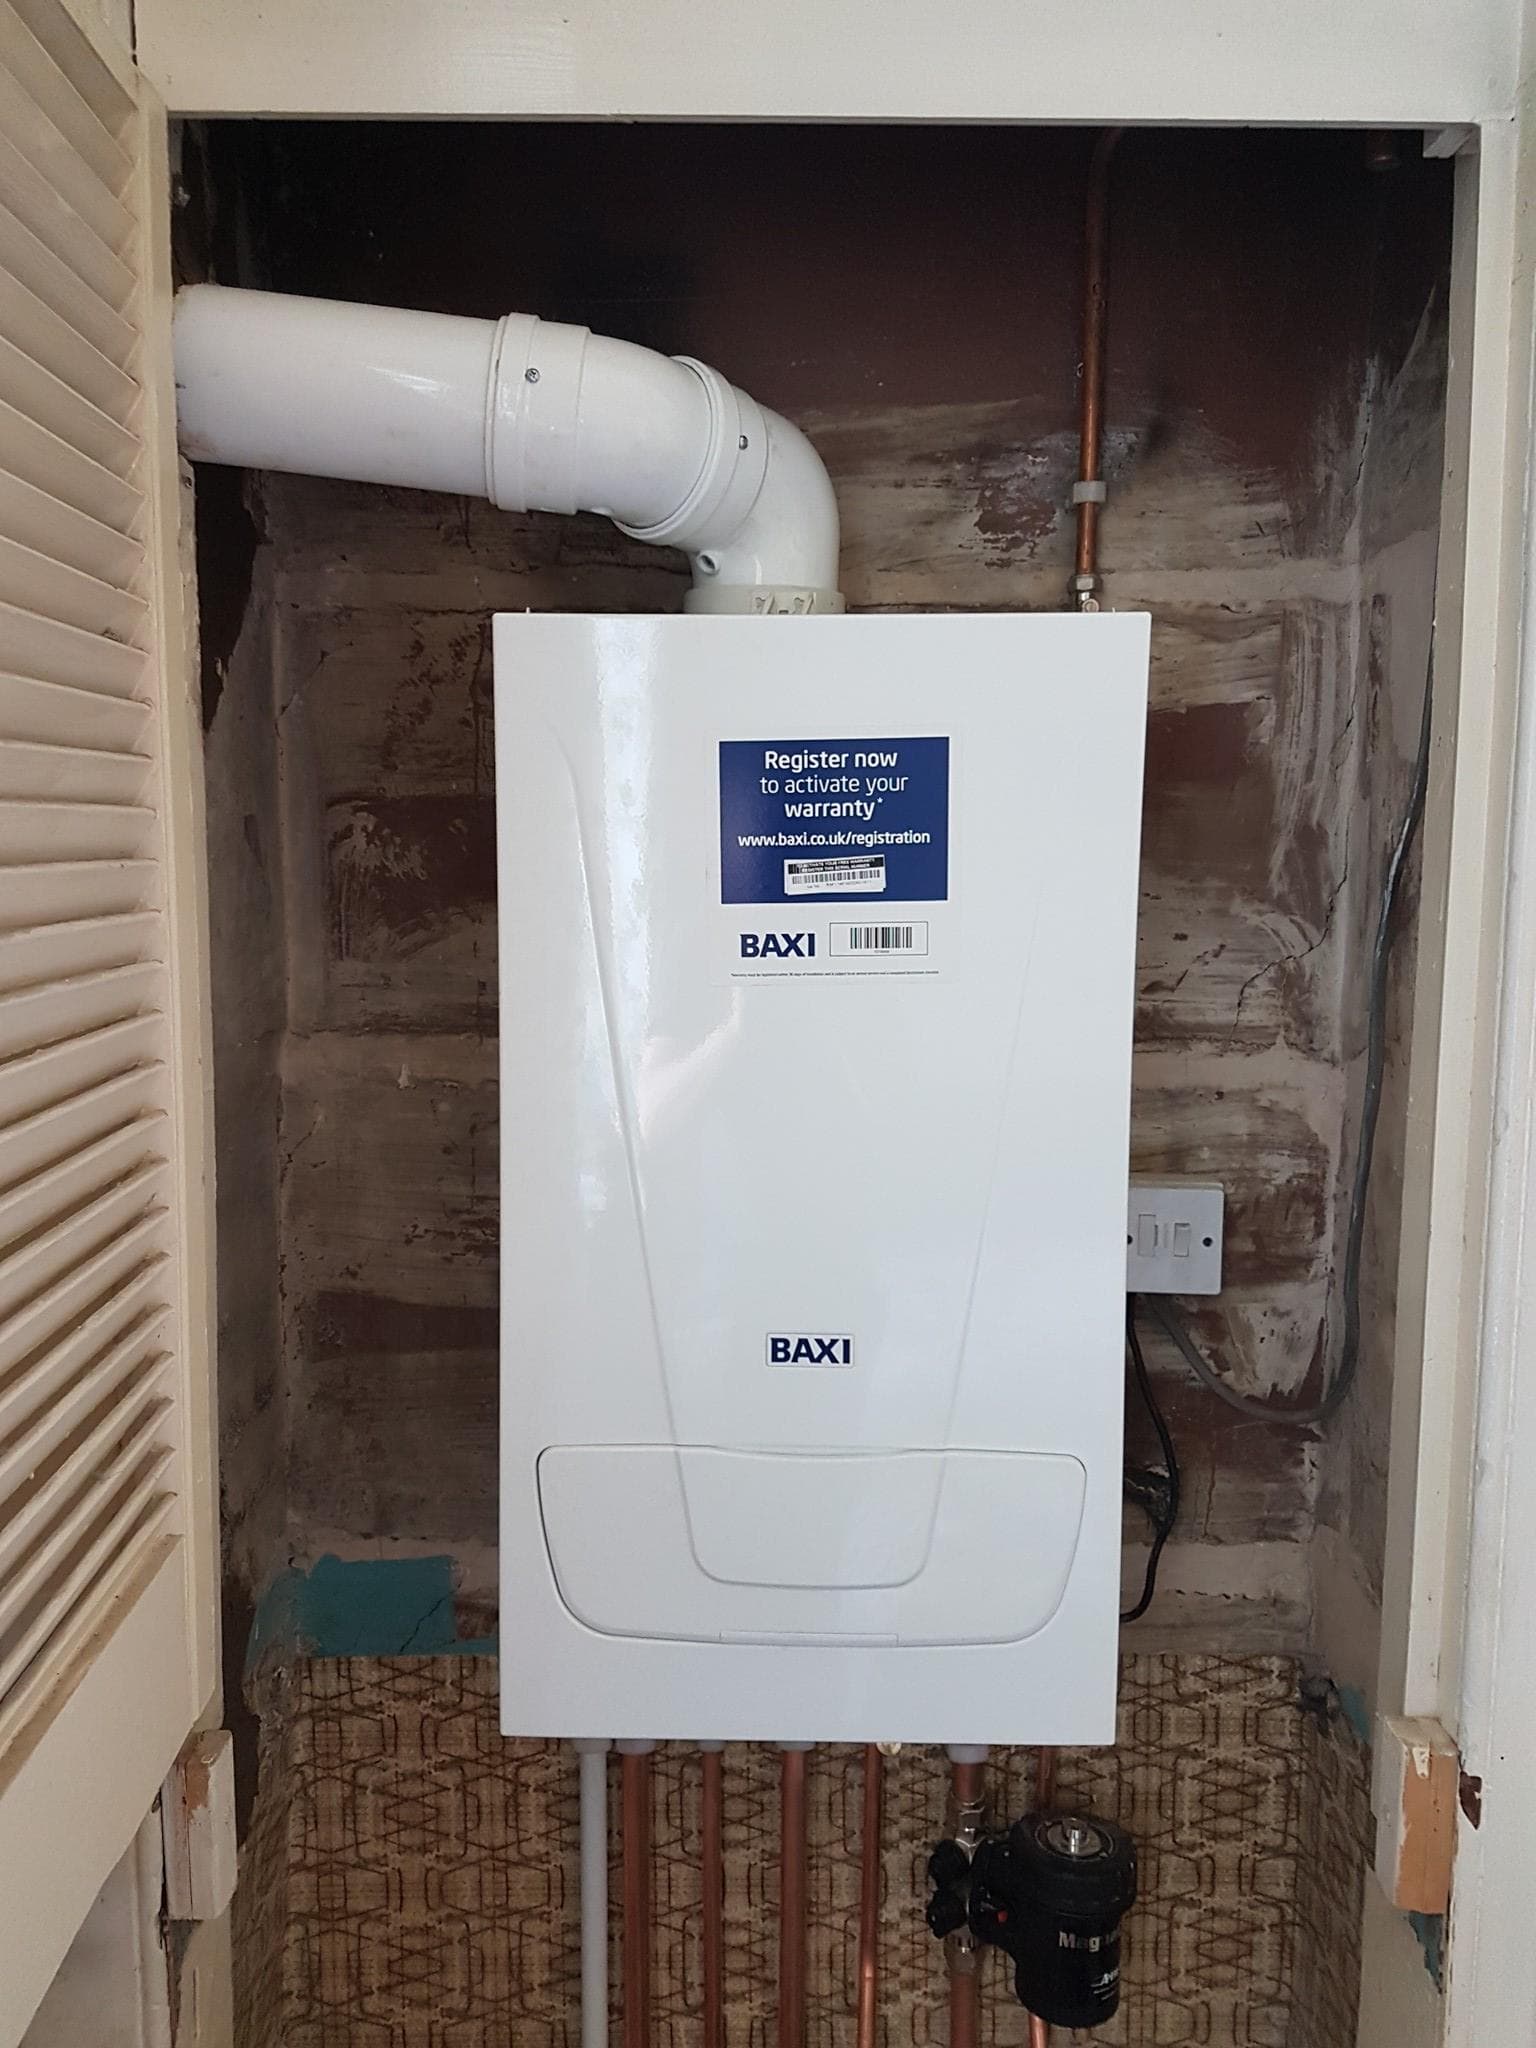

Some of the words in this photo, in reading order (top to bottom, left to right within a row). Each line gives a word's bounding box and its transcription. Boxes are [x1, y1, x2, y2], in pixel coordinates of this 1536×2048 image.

[764, 750, 849, 773] Register
[854, 752, 898, 768] now
[760, 776, 779, 794] to
[784, 775, 860, 793] activate
[865, 776, 908, 796] your
[738, 830, 931, 848] www.baxi.co.uk/registration
[740, 933, 816, 958] BAXI
[770, 1338, 851, 1364] BAXI
